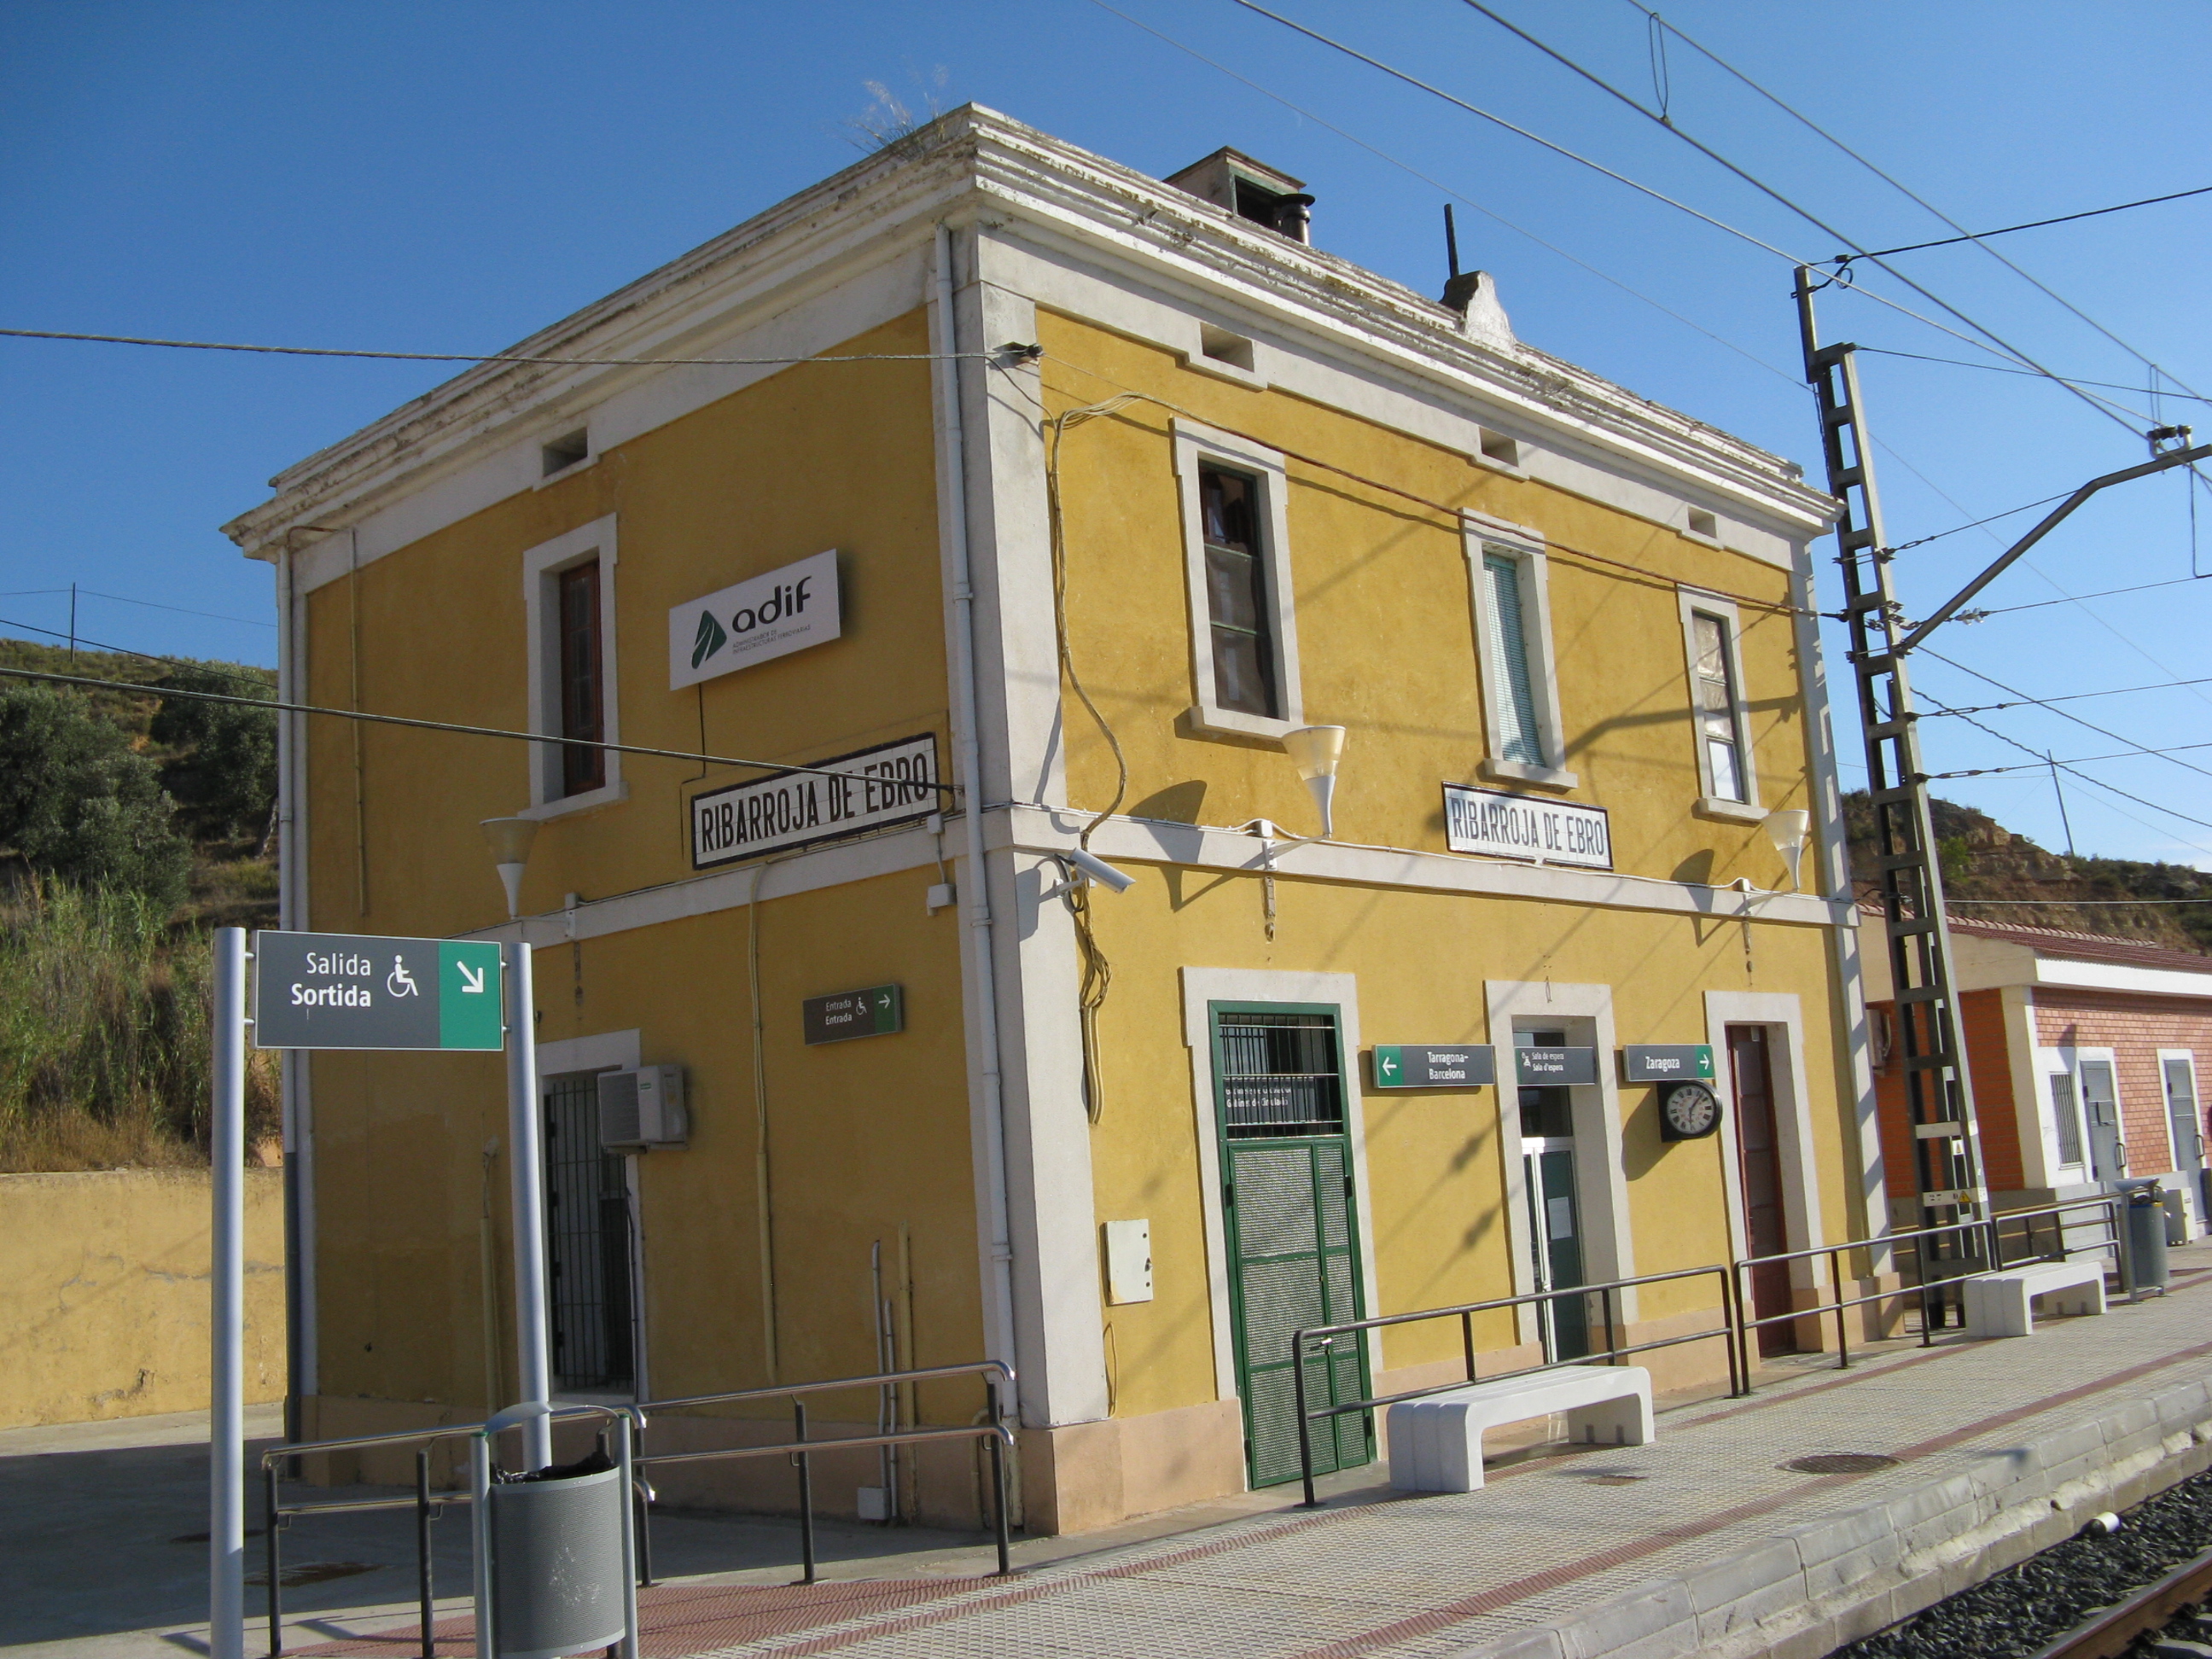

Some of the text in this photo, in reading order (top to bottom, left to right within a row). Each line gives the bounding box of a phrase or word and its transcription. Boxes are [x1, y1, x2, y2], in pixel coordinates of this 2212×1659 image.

[731, 575, 812, 633] adif
[701, 753, 928, 853] RIBARROJA DE EBRO
[1451, 798, 1604, 856] RIBARROJA DE EBRO
[306, 952, 371, 976] Salida
[291, 983, 371, 1007] Sortida
[825, 998, 853, 1011] Entrada
[825, 1012, 853, 1025] Entrada
[1427, 1051, 1469, 1066] Tarragona-
[1645, 1056, 1680, 1072] Zaragoza
[1429, 1068, 1466, 1080] Barcelona
